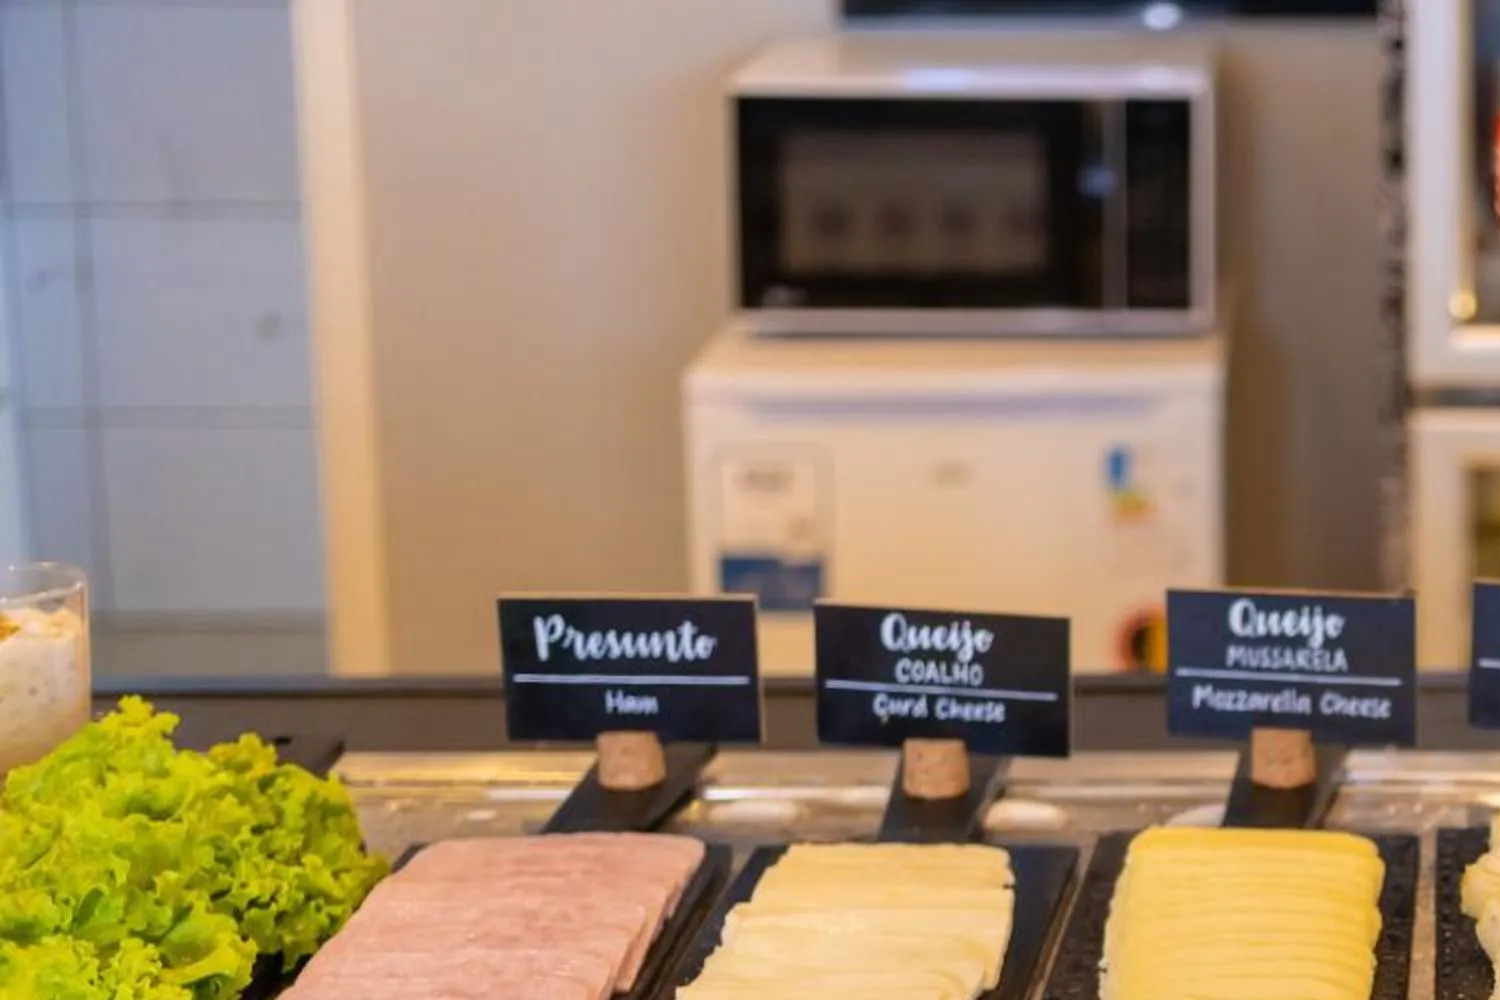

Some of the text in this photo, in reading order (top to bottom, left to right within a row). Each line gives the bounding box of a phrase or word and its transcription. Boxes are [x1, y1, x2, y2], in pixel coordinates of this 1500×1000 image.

[880, 612, 995, 663] Queijo
[1228, 597, 1346, 648] Queijo
[533, 613, 718, 663] Presunto
[894, 656, 985, 687] COALHO
[1225, 644, 1349, 673] MUSSARELA
[605, 689, 660, 715] Ham
[934, 697, 1007, 723] Cheese
[1319, 691, 1393, 719] Cheese
